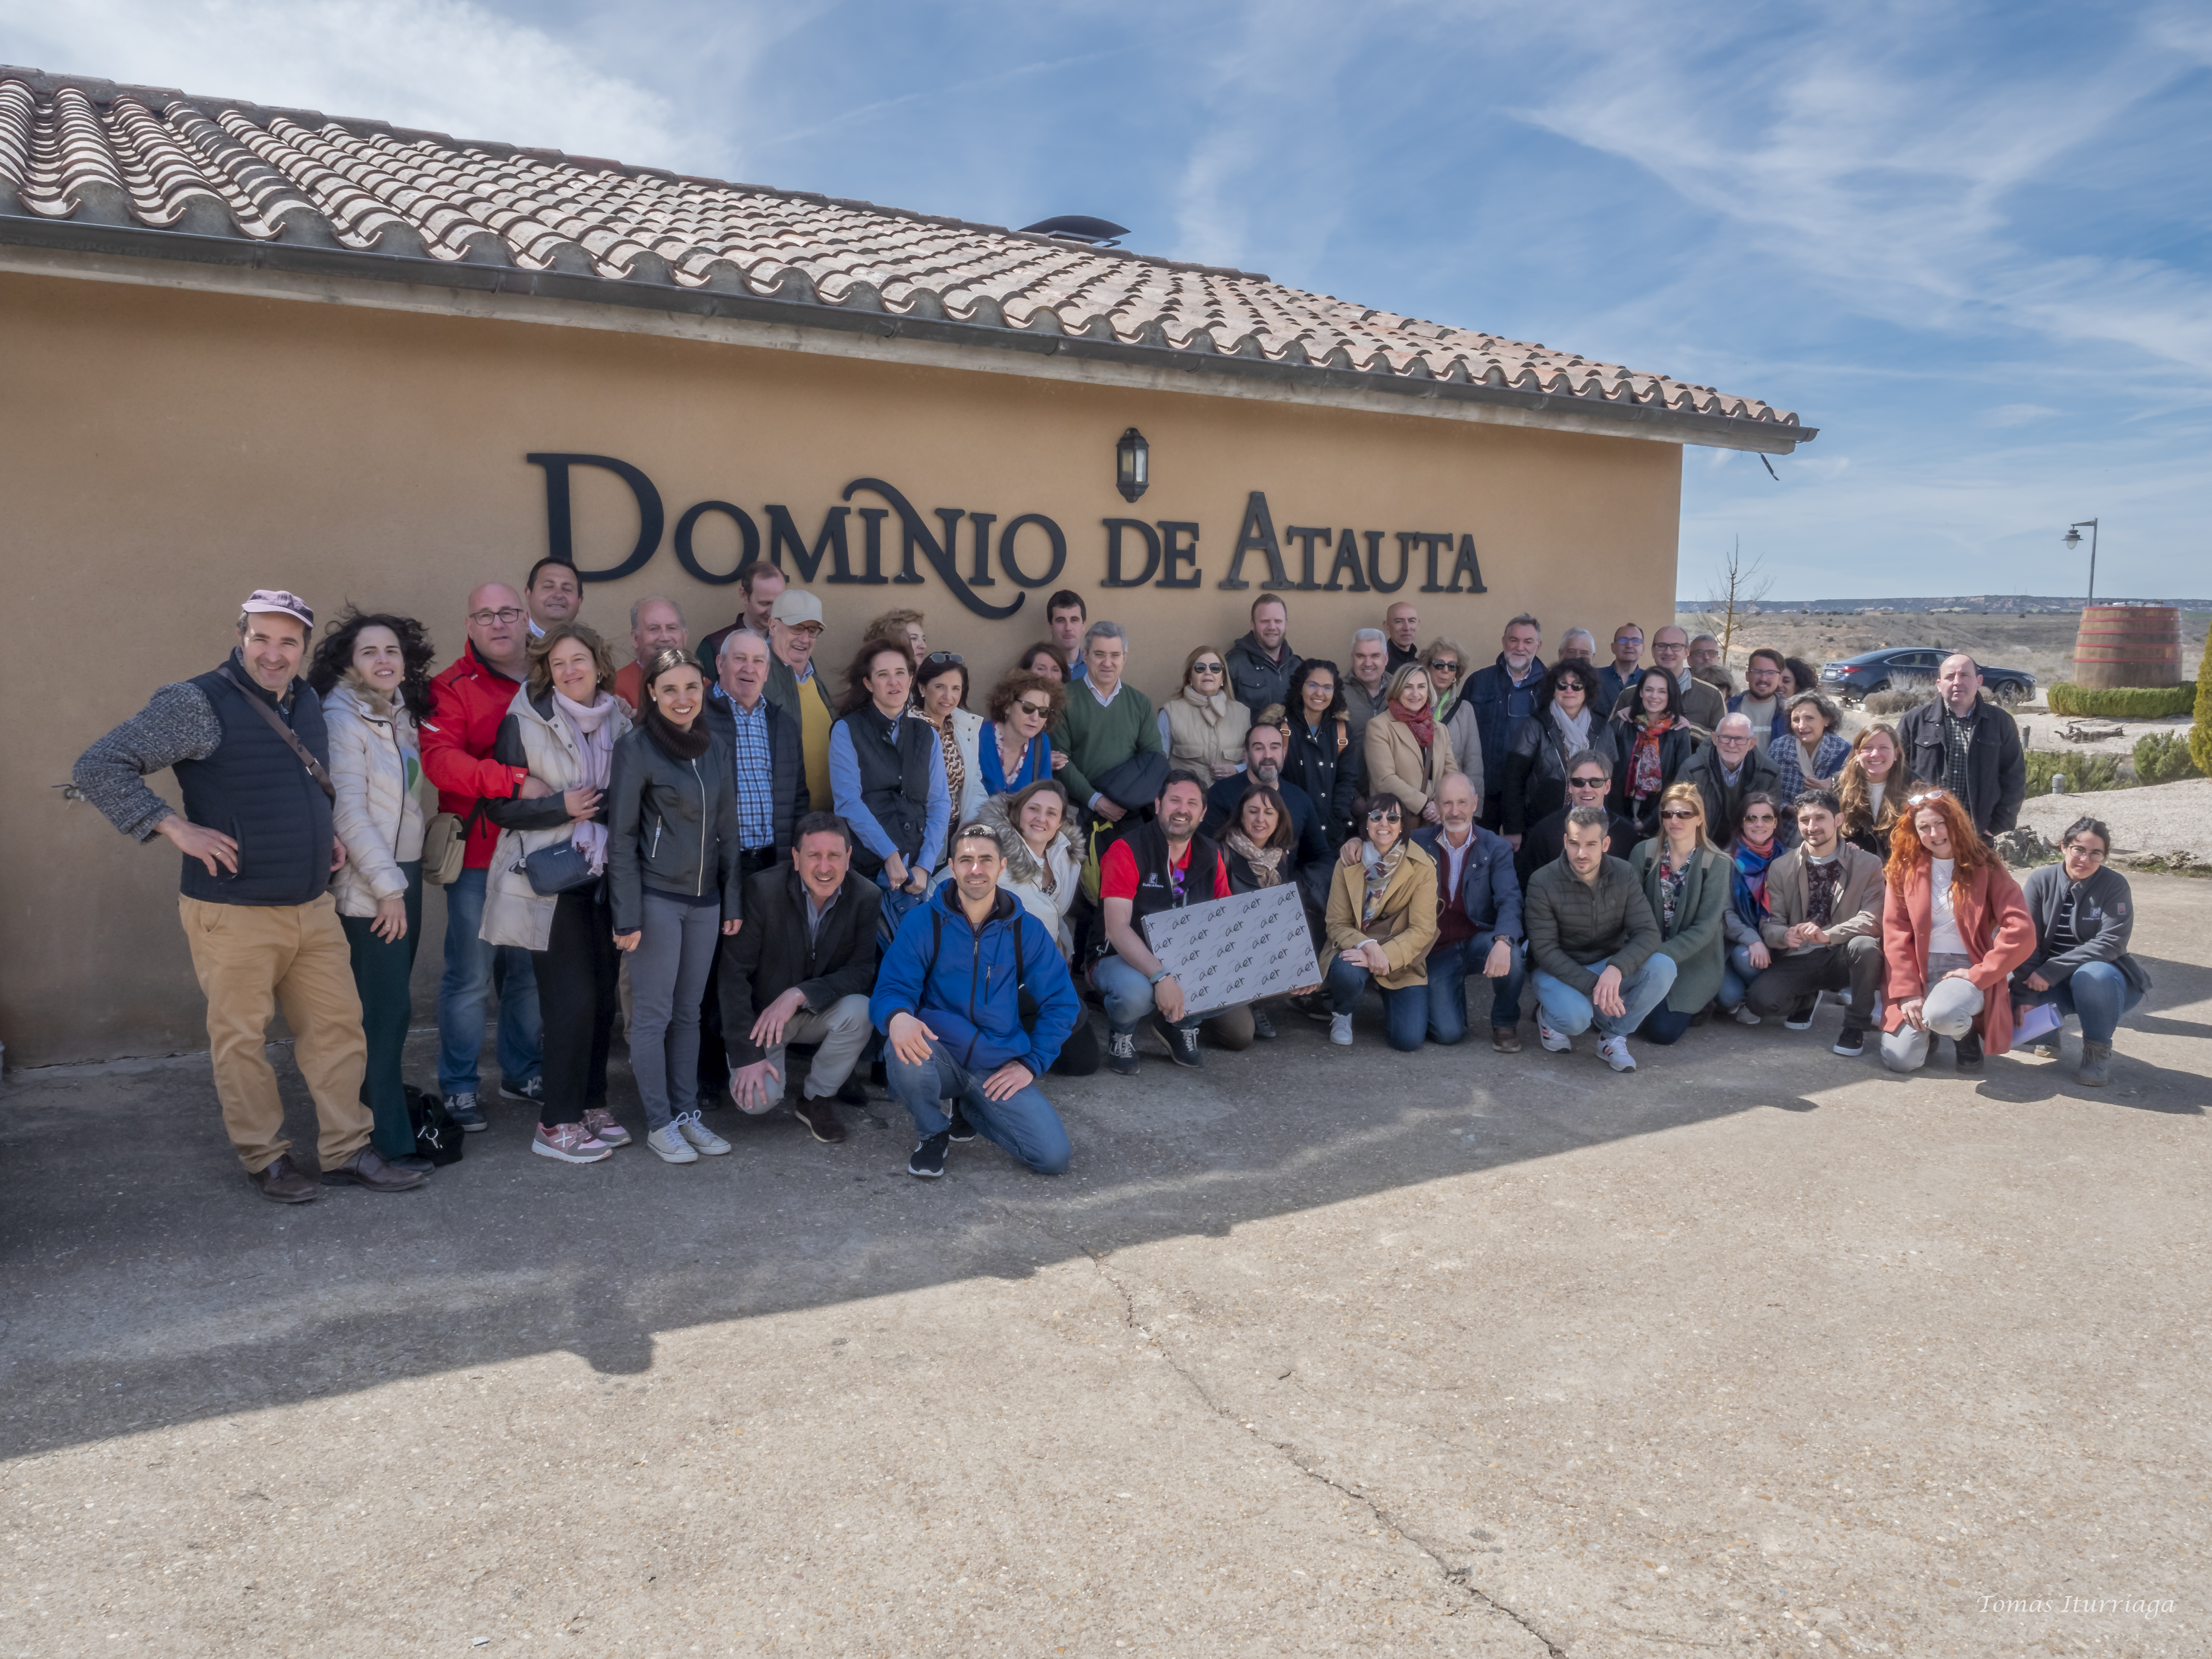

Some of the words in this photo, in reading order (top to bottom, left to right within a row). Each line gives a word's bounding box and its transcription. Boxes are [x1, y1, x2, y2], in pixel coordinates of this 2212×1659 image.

[1101, 518, 1202, 588] DE
[1220, 491, 1487, 593] ATAUTA
[1173, 914, 1191, 930] aer
[1208, 906, 1226, 922] aer
[1243, 898, 1261, 914] aer
[1278, 890, 1296, 905] aer
[1154, 937, 1173, 953] aer
[1190, 929, 1209, 945] aer
[1225, 921, 1244, 937] aer
[1260, 913, 1279, 928] aer
[1182, 950, 1200, 966] aer
[1217, 941, 1236, 958] aer
[1252, 934, 1271, 949] aer
[1287, 926, 1306, 941] aer
[1190, 986, 1209, 1002] aer
[1226, 977, 1245, 993] aer
[1262, 969, 1280, 985] aer
[1297, 961, 1315, 977] aer
[1199, 965, 1218, 981] aer
[1235, 957, 1253, 972] aer
[1270, 948, 1289, 964] aer
